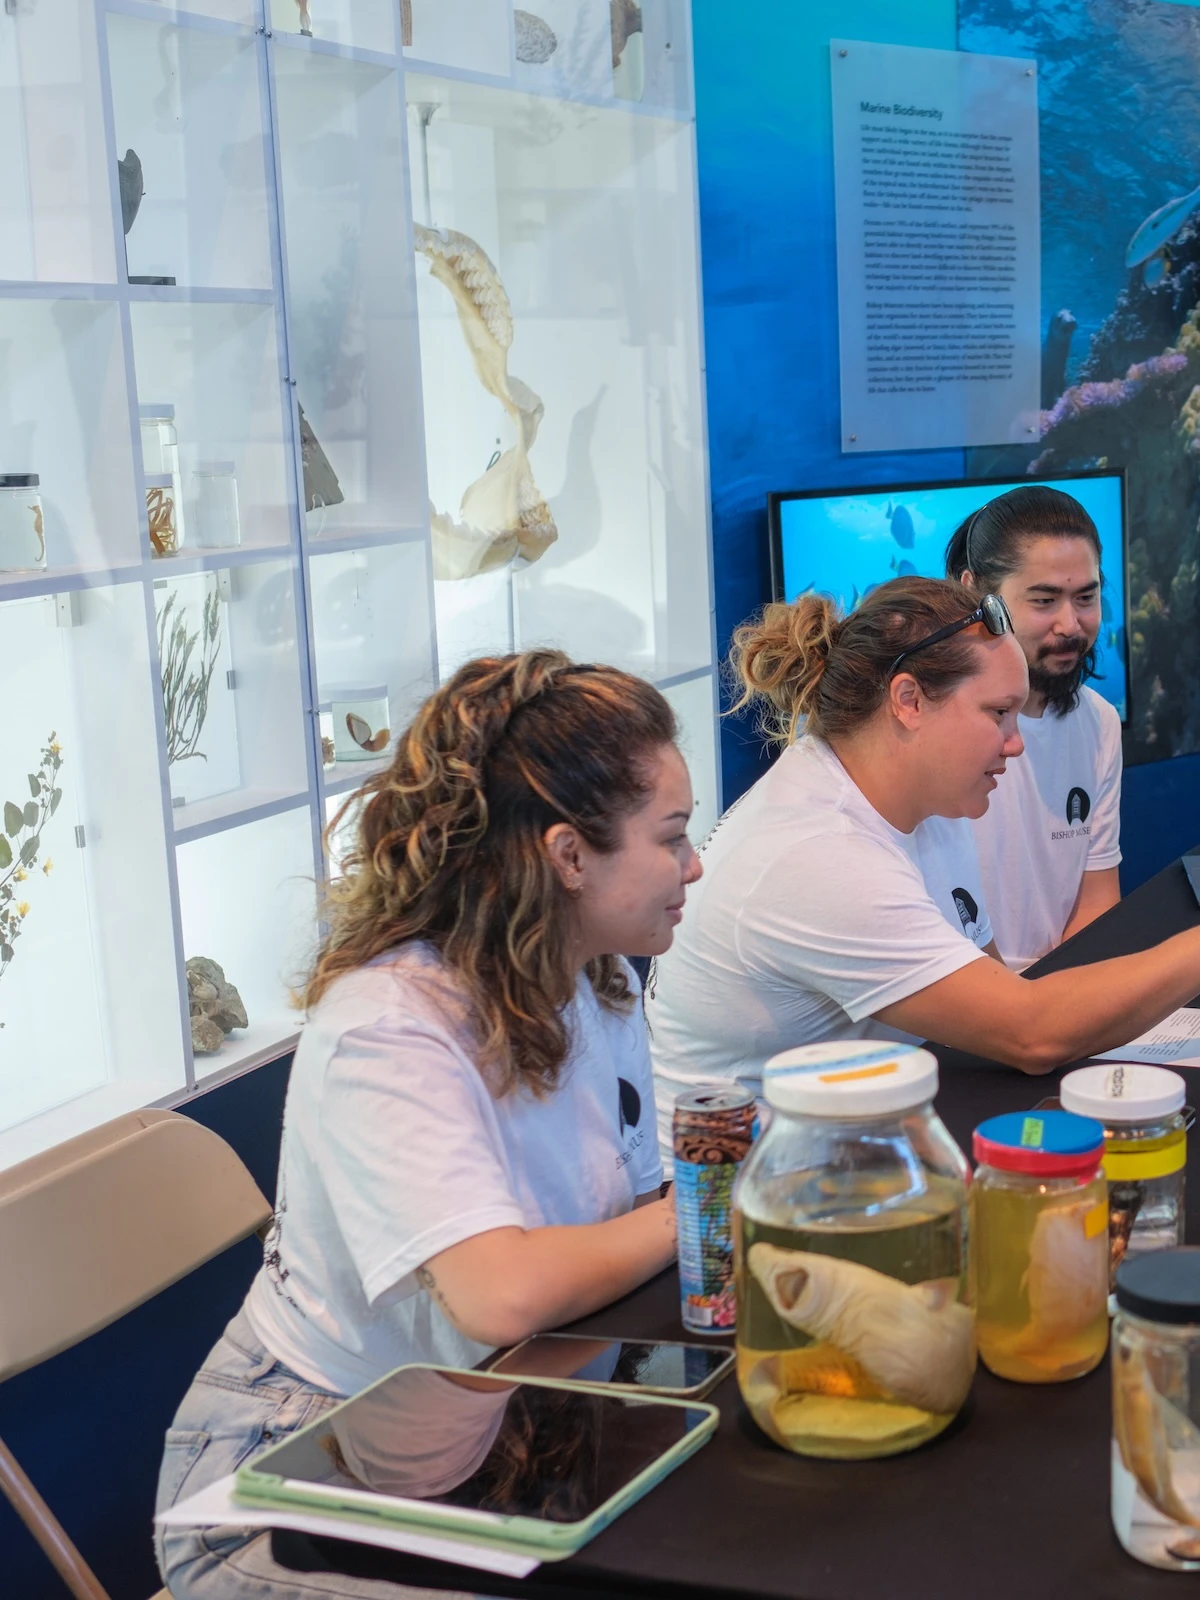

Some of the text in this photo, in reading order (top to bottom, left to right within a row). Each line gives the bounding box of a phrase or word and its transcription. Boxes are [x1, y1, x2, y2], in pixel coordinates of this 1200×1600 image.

[860, 101, 943, 121] Marine Biodiversity
[1051, 830, 1075, 840] BISHOP
